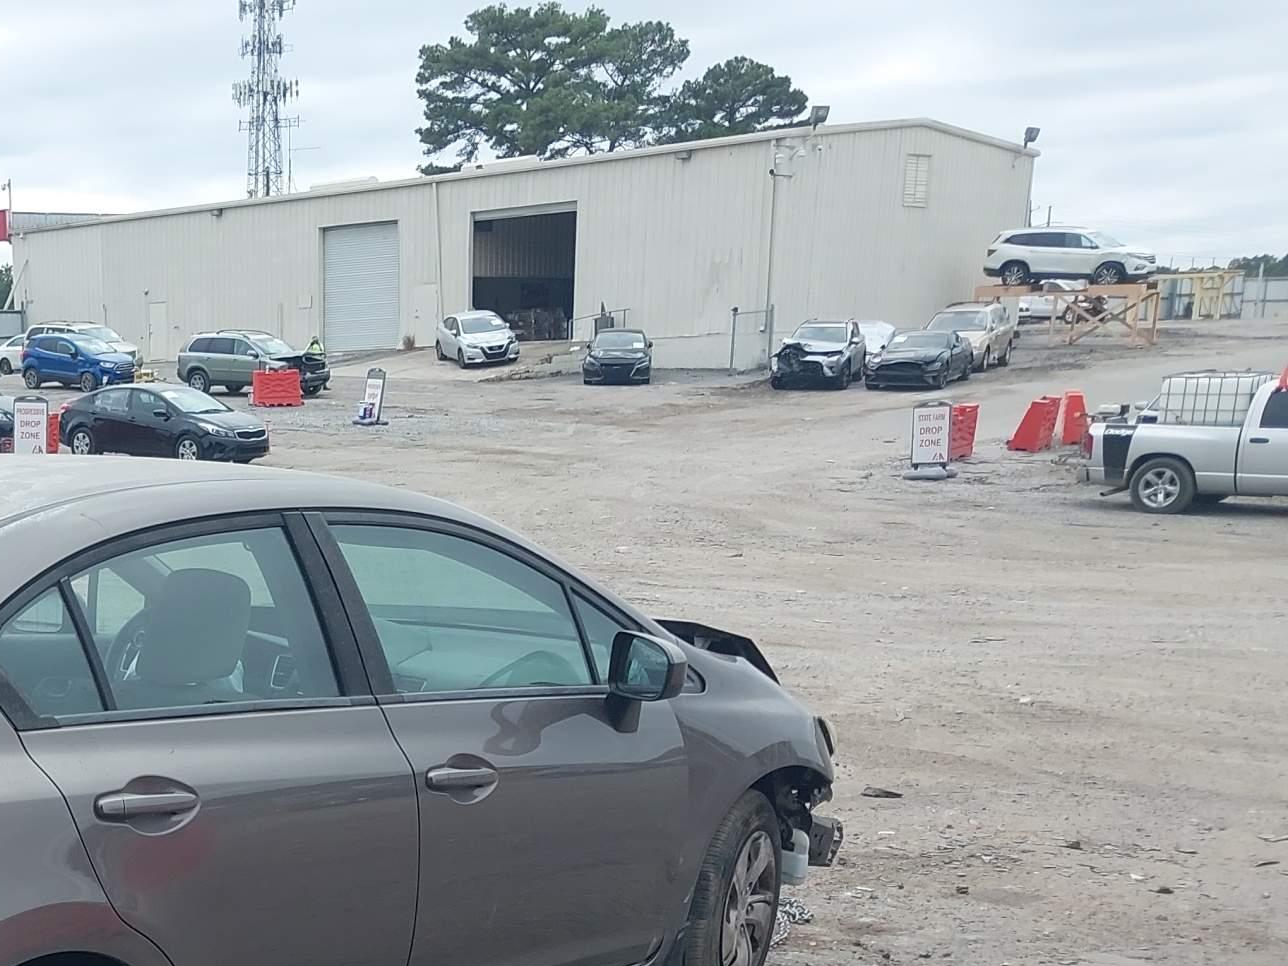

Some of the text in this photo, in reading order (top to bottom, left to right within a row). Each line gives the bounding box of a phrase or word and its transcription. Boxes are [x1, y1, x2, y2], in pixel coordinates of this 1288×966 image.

[918, 413, 946, 422] STATE FARM
[20, 420, 41, 428] DROP
[919, 426, 943, 435] DROP
[20, 432, 41, 440] ZONE
[919, 439, 942, 447] ZONE
